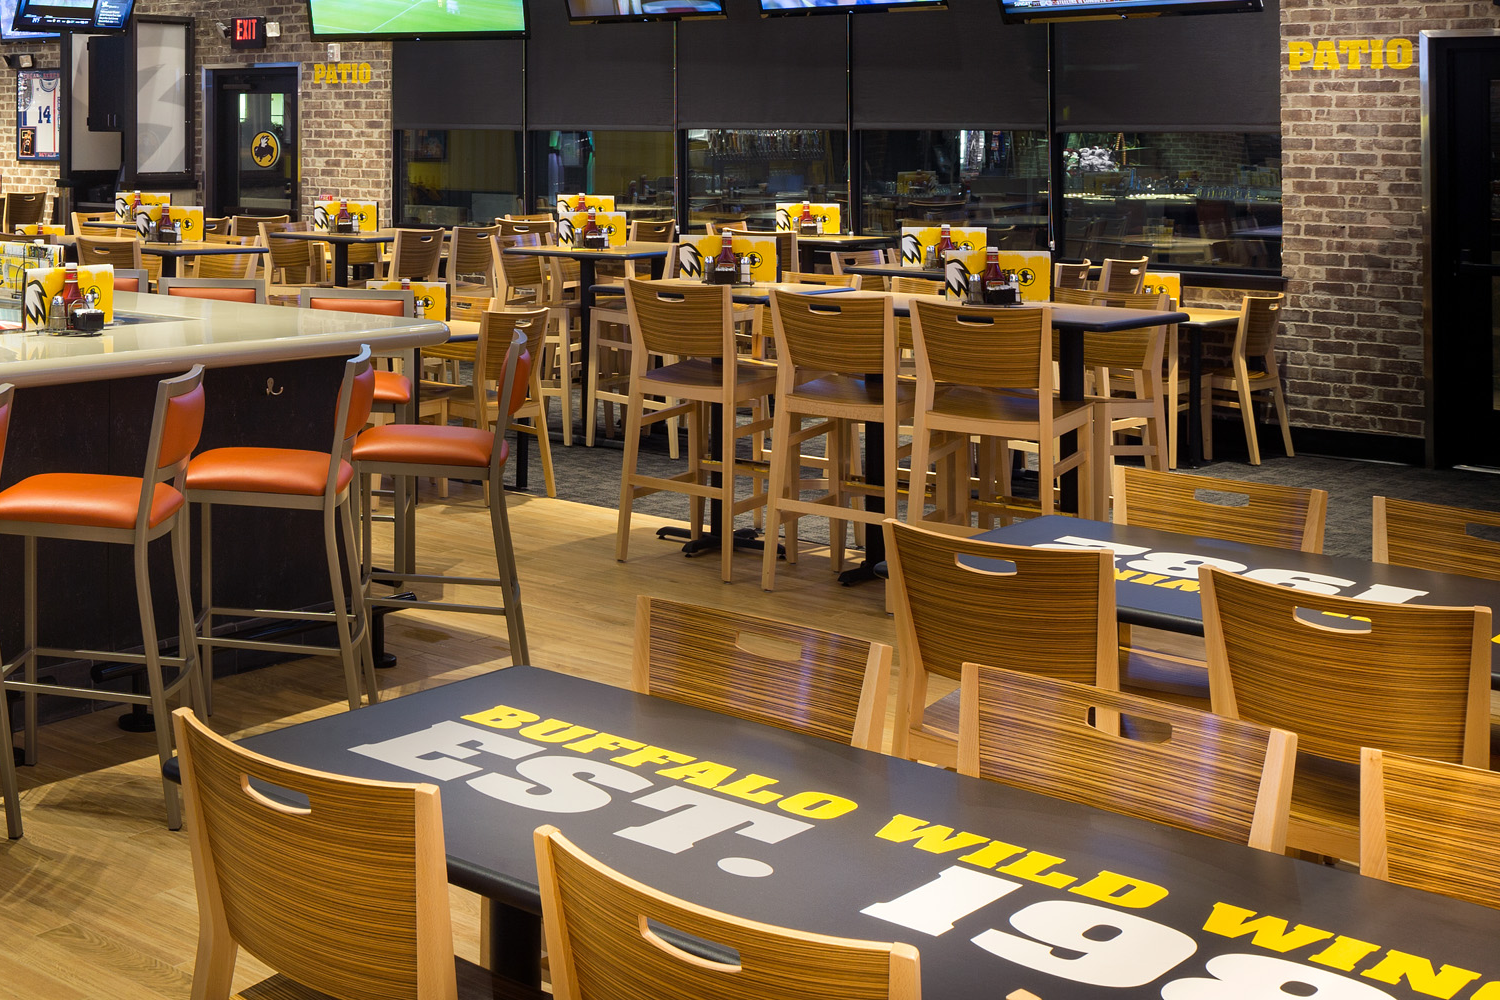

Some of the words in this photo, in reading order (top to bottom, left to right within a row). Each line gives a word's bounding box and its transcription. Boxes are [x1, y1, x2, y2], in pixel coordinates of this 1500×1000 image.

[236, 18, 257, 41] EXIT
[1288, 38, 1413, 70] PATIO
[313, 62, 371, 84] PATIO
[38, 105, 52, 124] 14
[347, 720, 816, 878] EST.
[460, 704, 859, 820] BUFFALO
[874, 813, 1169, 909] WILD
[1202, 901, 1500, 1000] WIN
